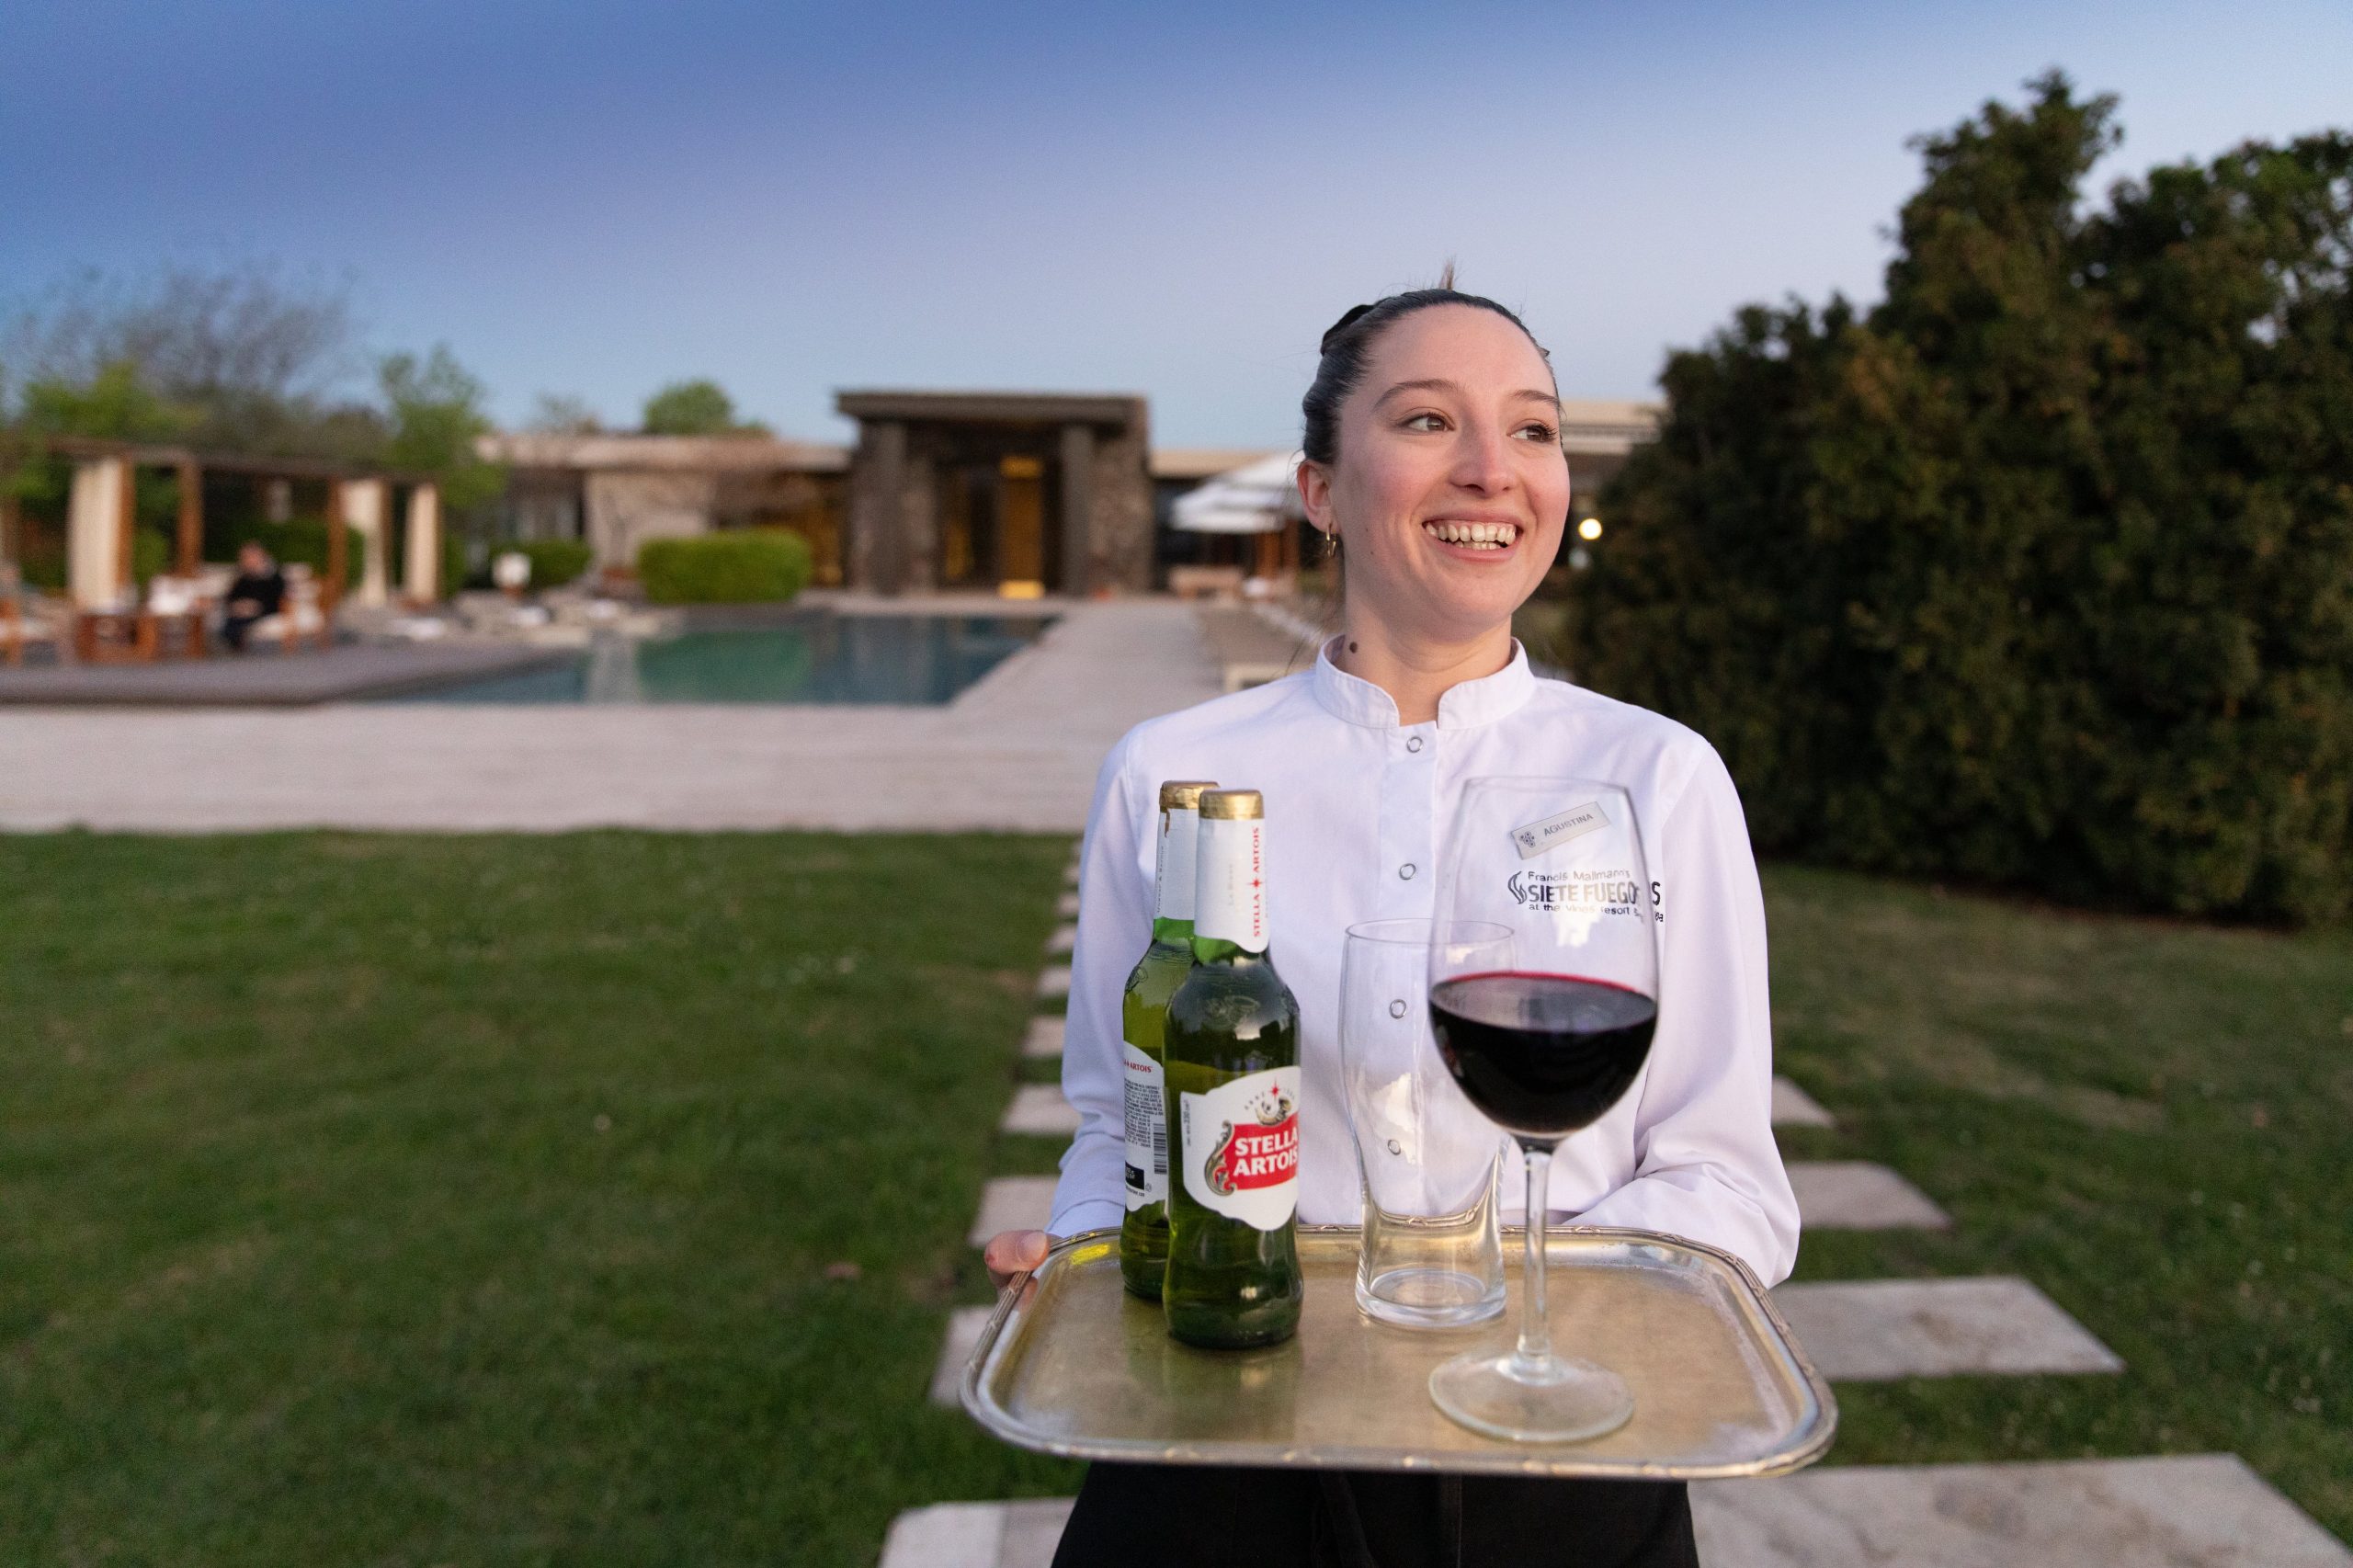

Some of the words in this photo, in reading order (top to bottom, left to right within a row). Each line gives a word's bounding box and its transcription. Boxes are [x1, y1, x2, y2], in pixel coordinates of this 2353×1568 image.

[1543, 813, 1594, 837] AGUSTINA
[1528, 870, 1568, 881] Francis
[1528, 883, 1580, 903] SIETE
[1543, 903, 1561, 912] the
[1130, 1062, 1153, 1074] ARTOIS
[1234, 1127, 1298, 1156] STELLA
[1233, 1148, 1298, 1177] ARTOIS
